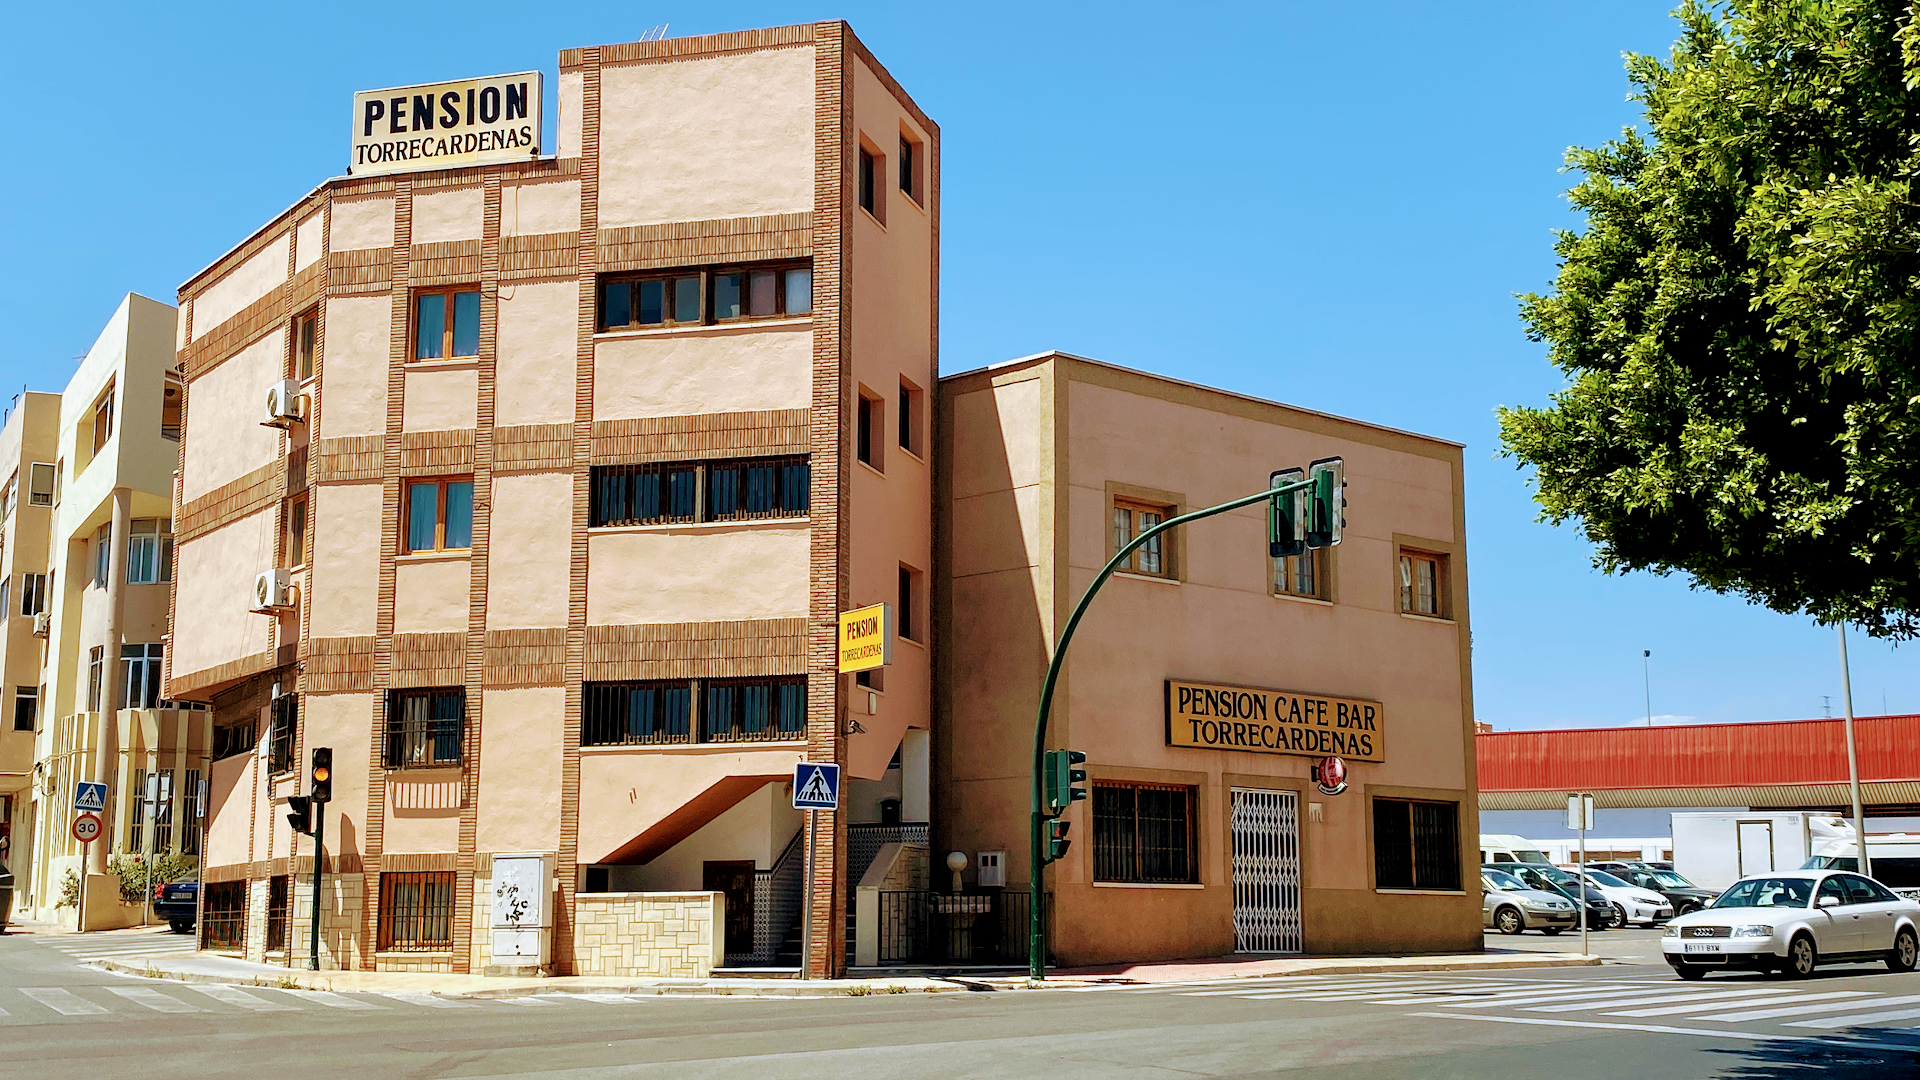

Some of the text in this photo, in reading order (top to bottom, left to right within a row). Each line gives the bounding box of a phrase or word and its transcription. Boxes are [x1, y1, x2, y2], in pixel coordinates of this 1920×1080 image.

[364, 83, 528, 136] PENSION
[356, 126, 532, 164] TORRECARDENAS
[847, 616, 877, 641] PENSION
[842, 643, 882, 662] TORRECARDENAS
[1178, 687, 1376, 731] PENSION CAFE BAR
[1188, 719, 1373, 756] TORRECARDENAS
[78, 823, 96, 833] 30
